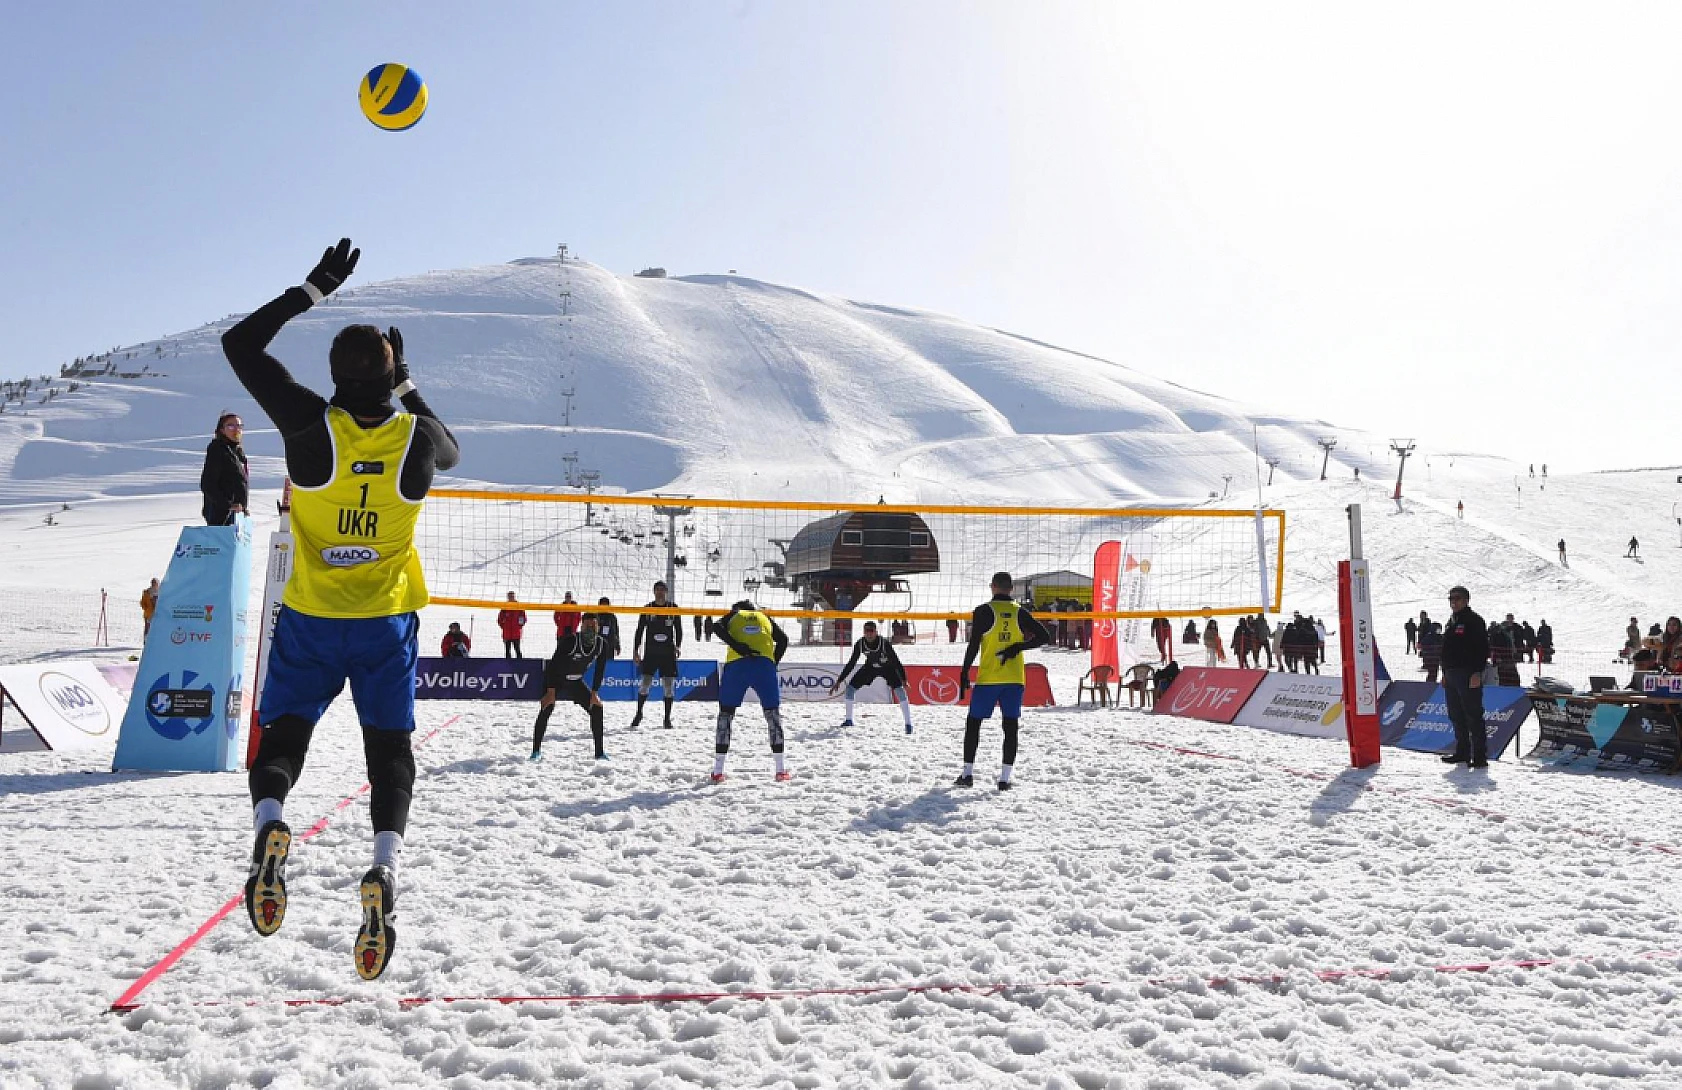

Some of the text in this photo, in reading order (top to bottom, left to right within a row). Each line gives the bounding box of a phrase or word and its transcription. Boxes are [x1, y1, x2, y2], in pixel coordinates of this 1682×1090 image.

[360, 482, 369, 508] 1
[338, 508, 378, 537] UKR
[330, 549, 371, 560] MADO
[1102, 580, 1113, 612] TVF
[189, 631, 212, 643] TVF
[601, 676, 707, 689] Snowolyball
[780, 676, 834, 688] MADO
[1197, 686, 1238, 709] TVF
[1416, 702, 1436, 714] CEV
[1404, 717, 1449, 733] European
[1485, 726, 1498, 738] 22
